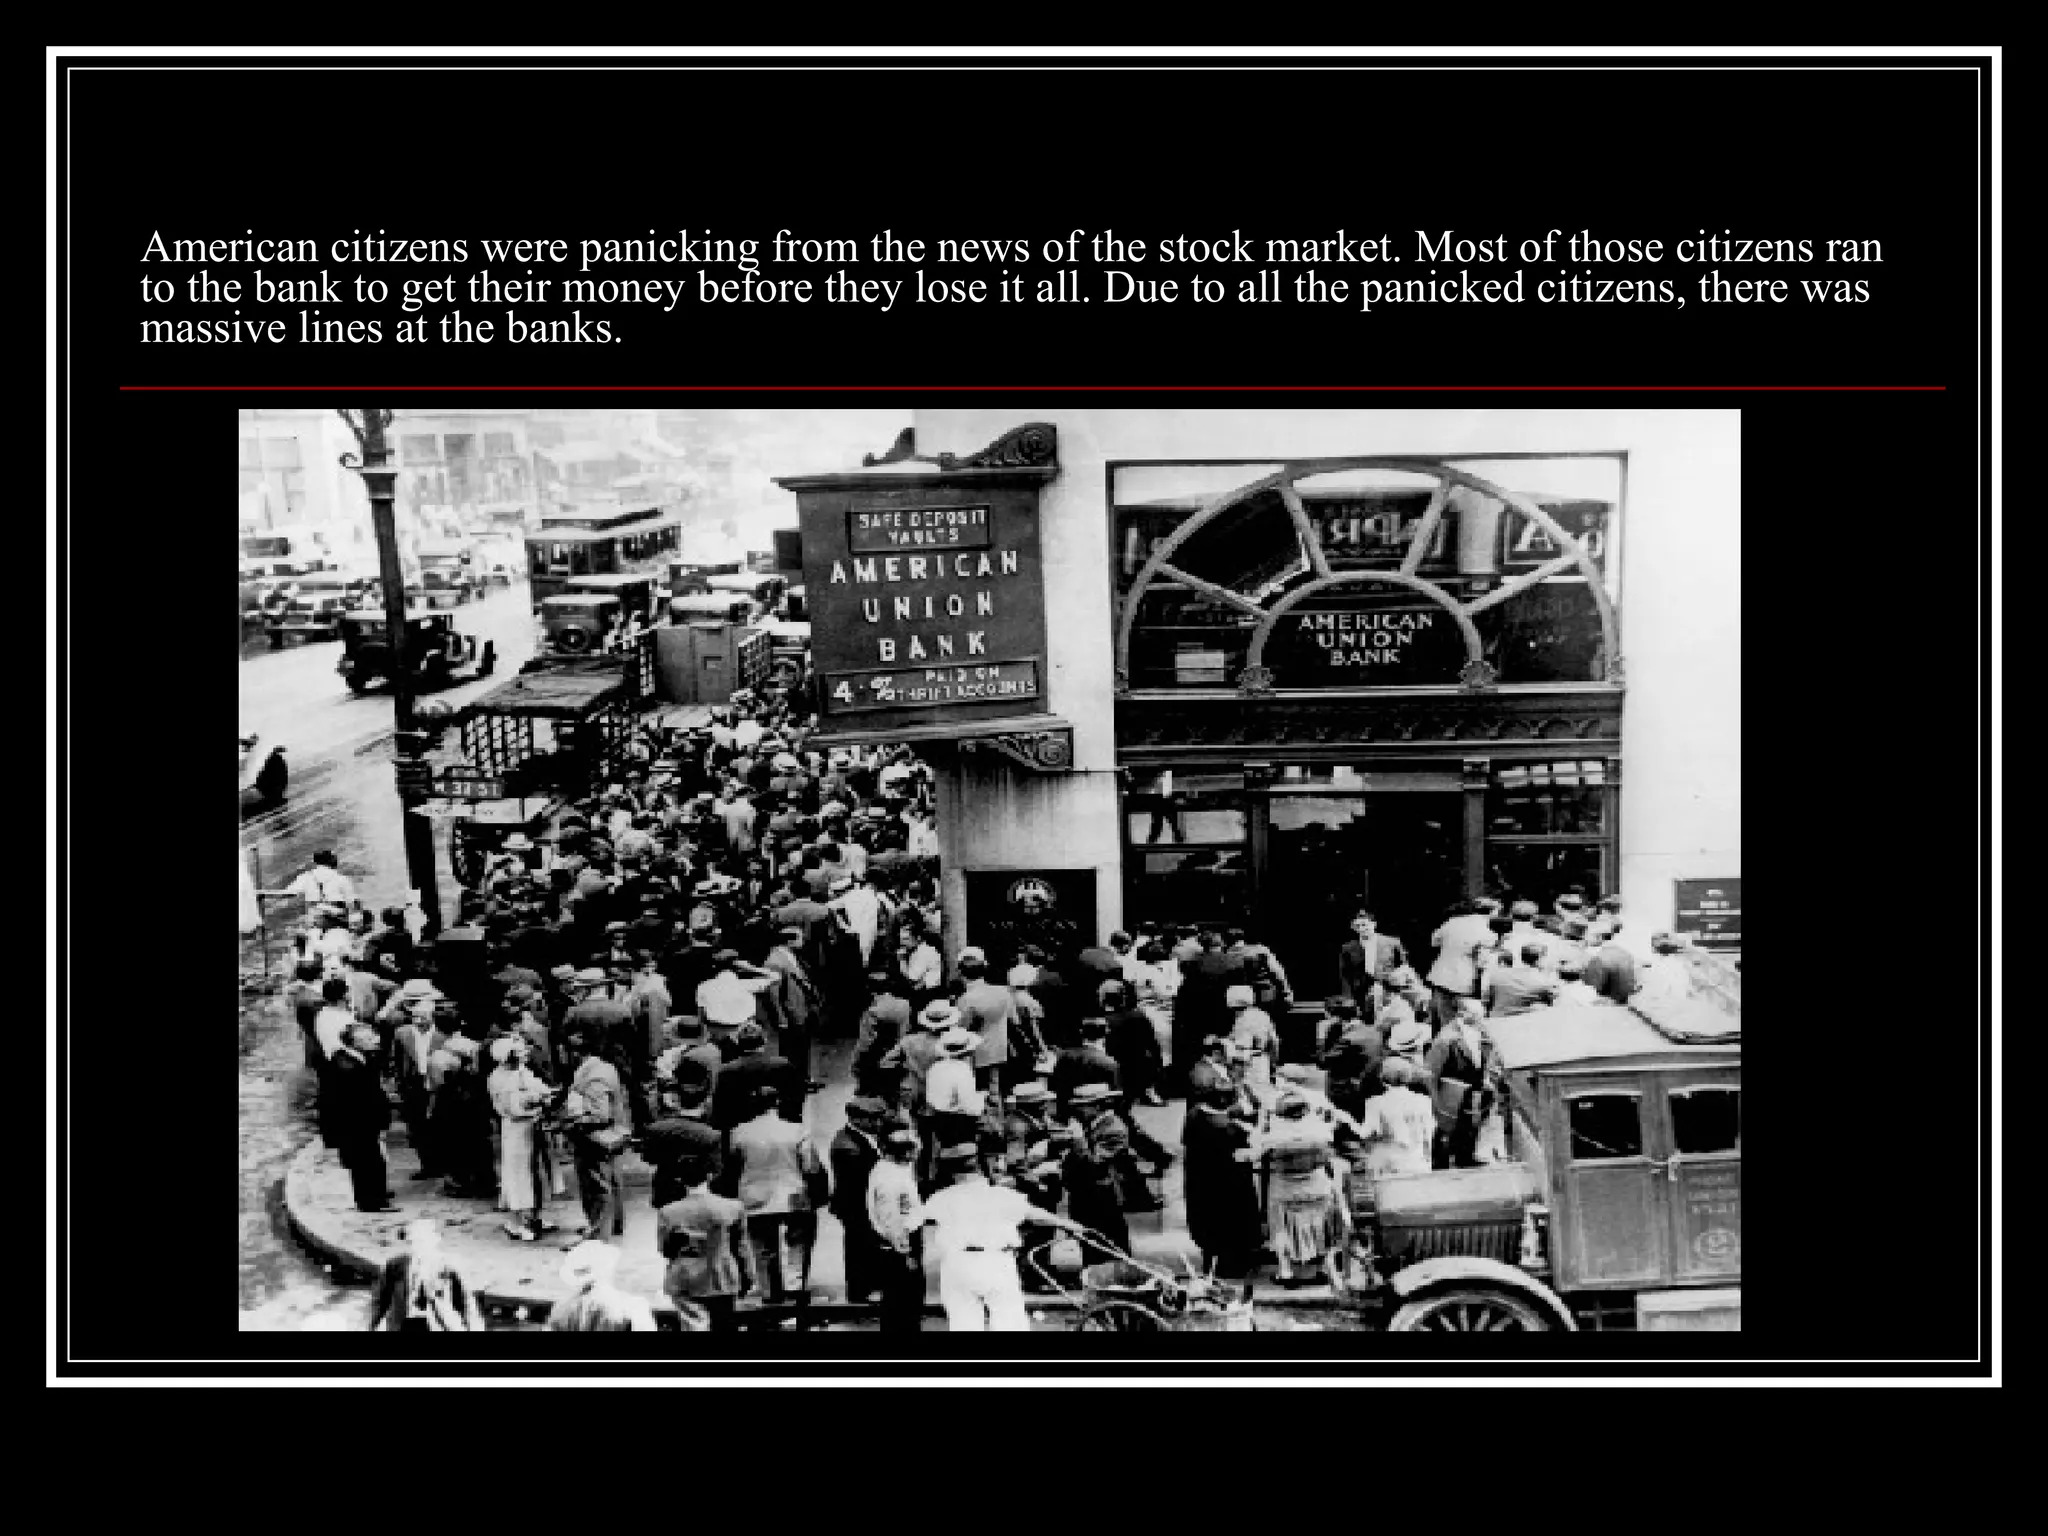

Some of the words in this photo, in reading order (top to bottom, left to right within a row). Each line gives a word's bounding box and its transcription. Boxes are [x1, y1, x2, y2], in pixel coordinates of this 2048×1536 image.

[830, 550, 1017, 583] AMERICAN
[862, 591, 993, 623] UNION
[1299, 613, 1433, 631] AMERICAN
[878, 630, 986, 662] BANK
[1316, 630, 1413, 648] UNION
[1330, 648, 1401, 666] BANK
